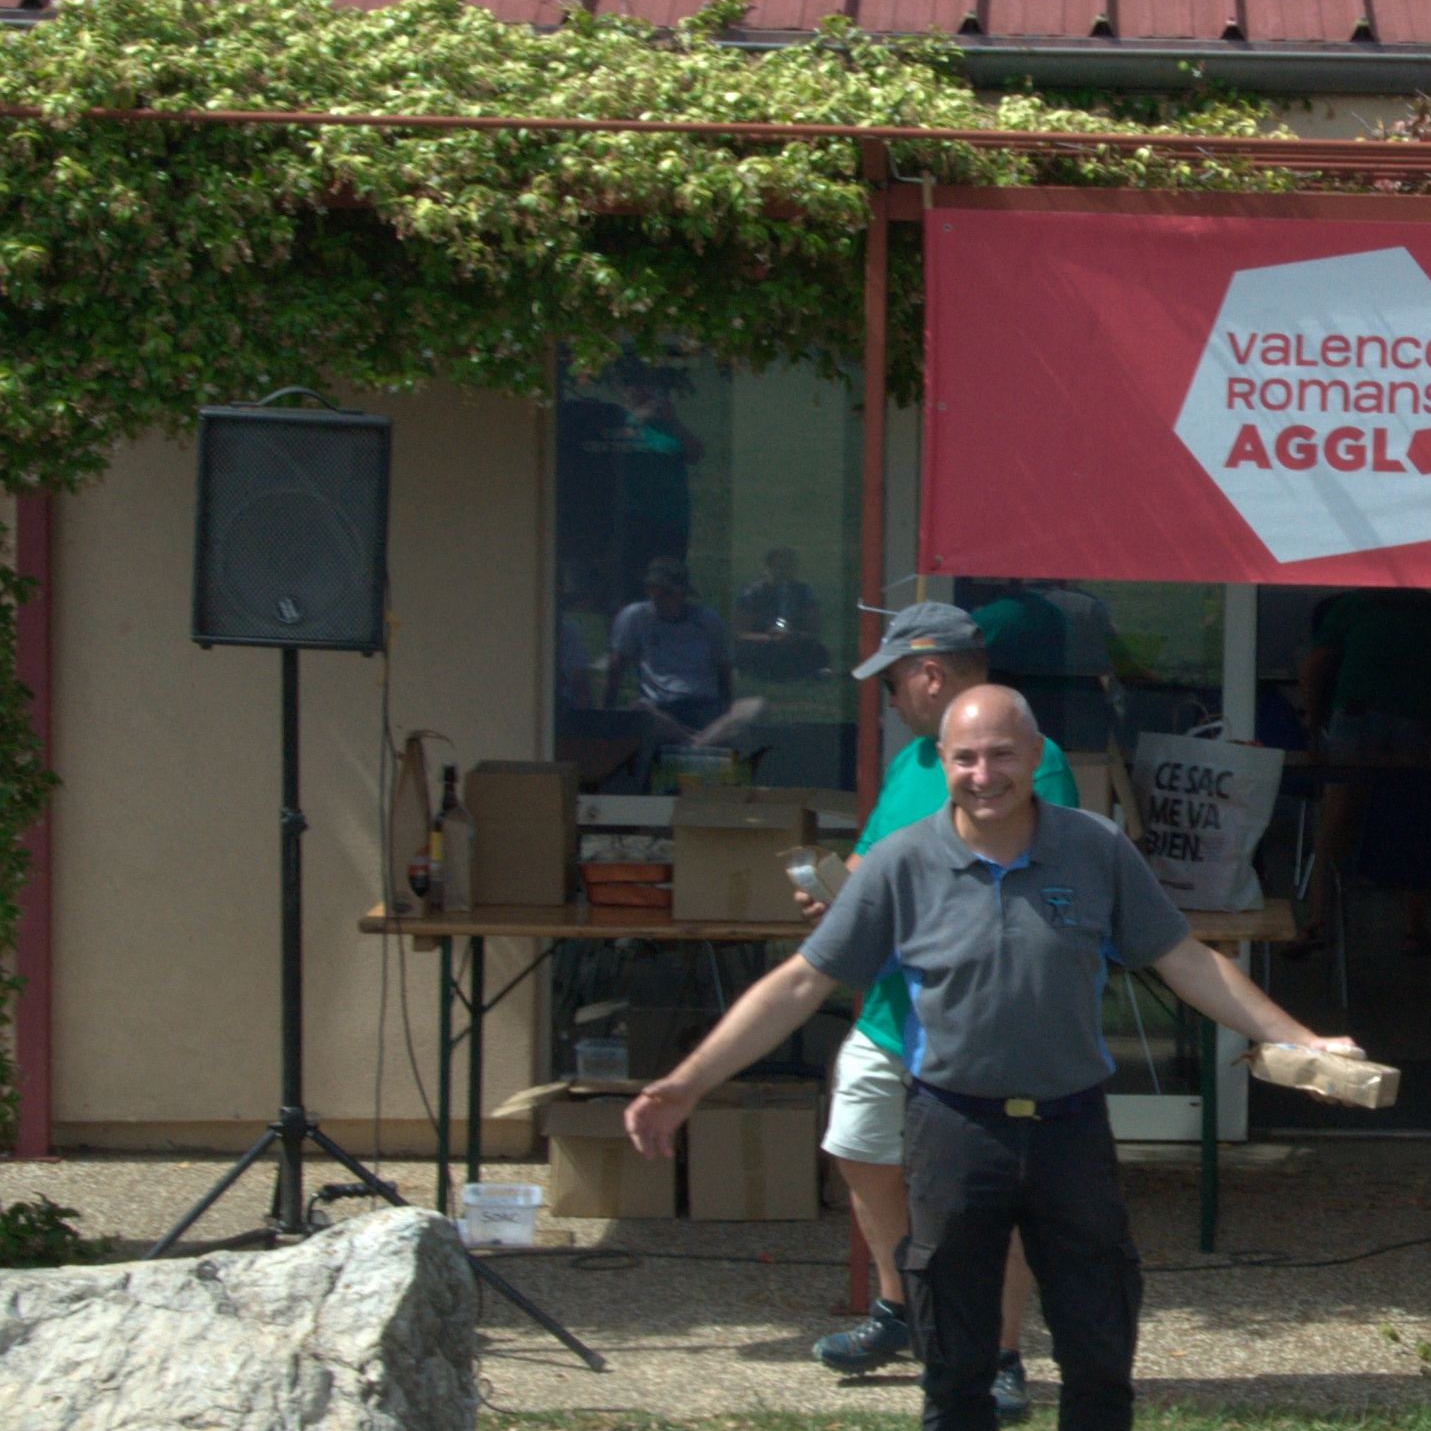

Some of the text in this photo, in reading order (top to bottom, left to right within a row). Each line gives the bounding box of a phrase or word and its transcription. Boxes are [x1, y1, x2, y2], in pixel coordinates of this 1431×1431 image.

[1154, 761, 1235, 799] CE SAC
[1148, 795, 1221, 830] ME VA
